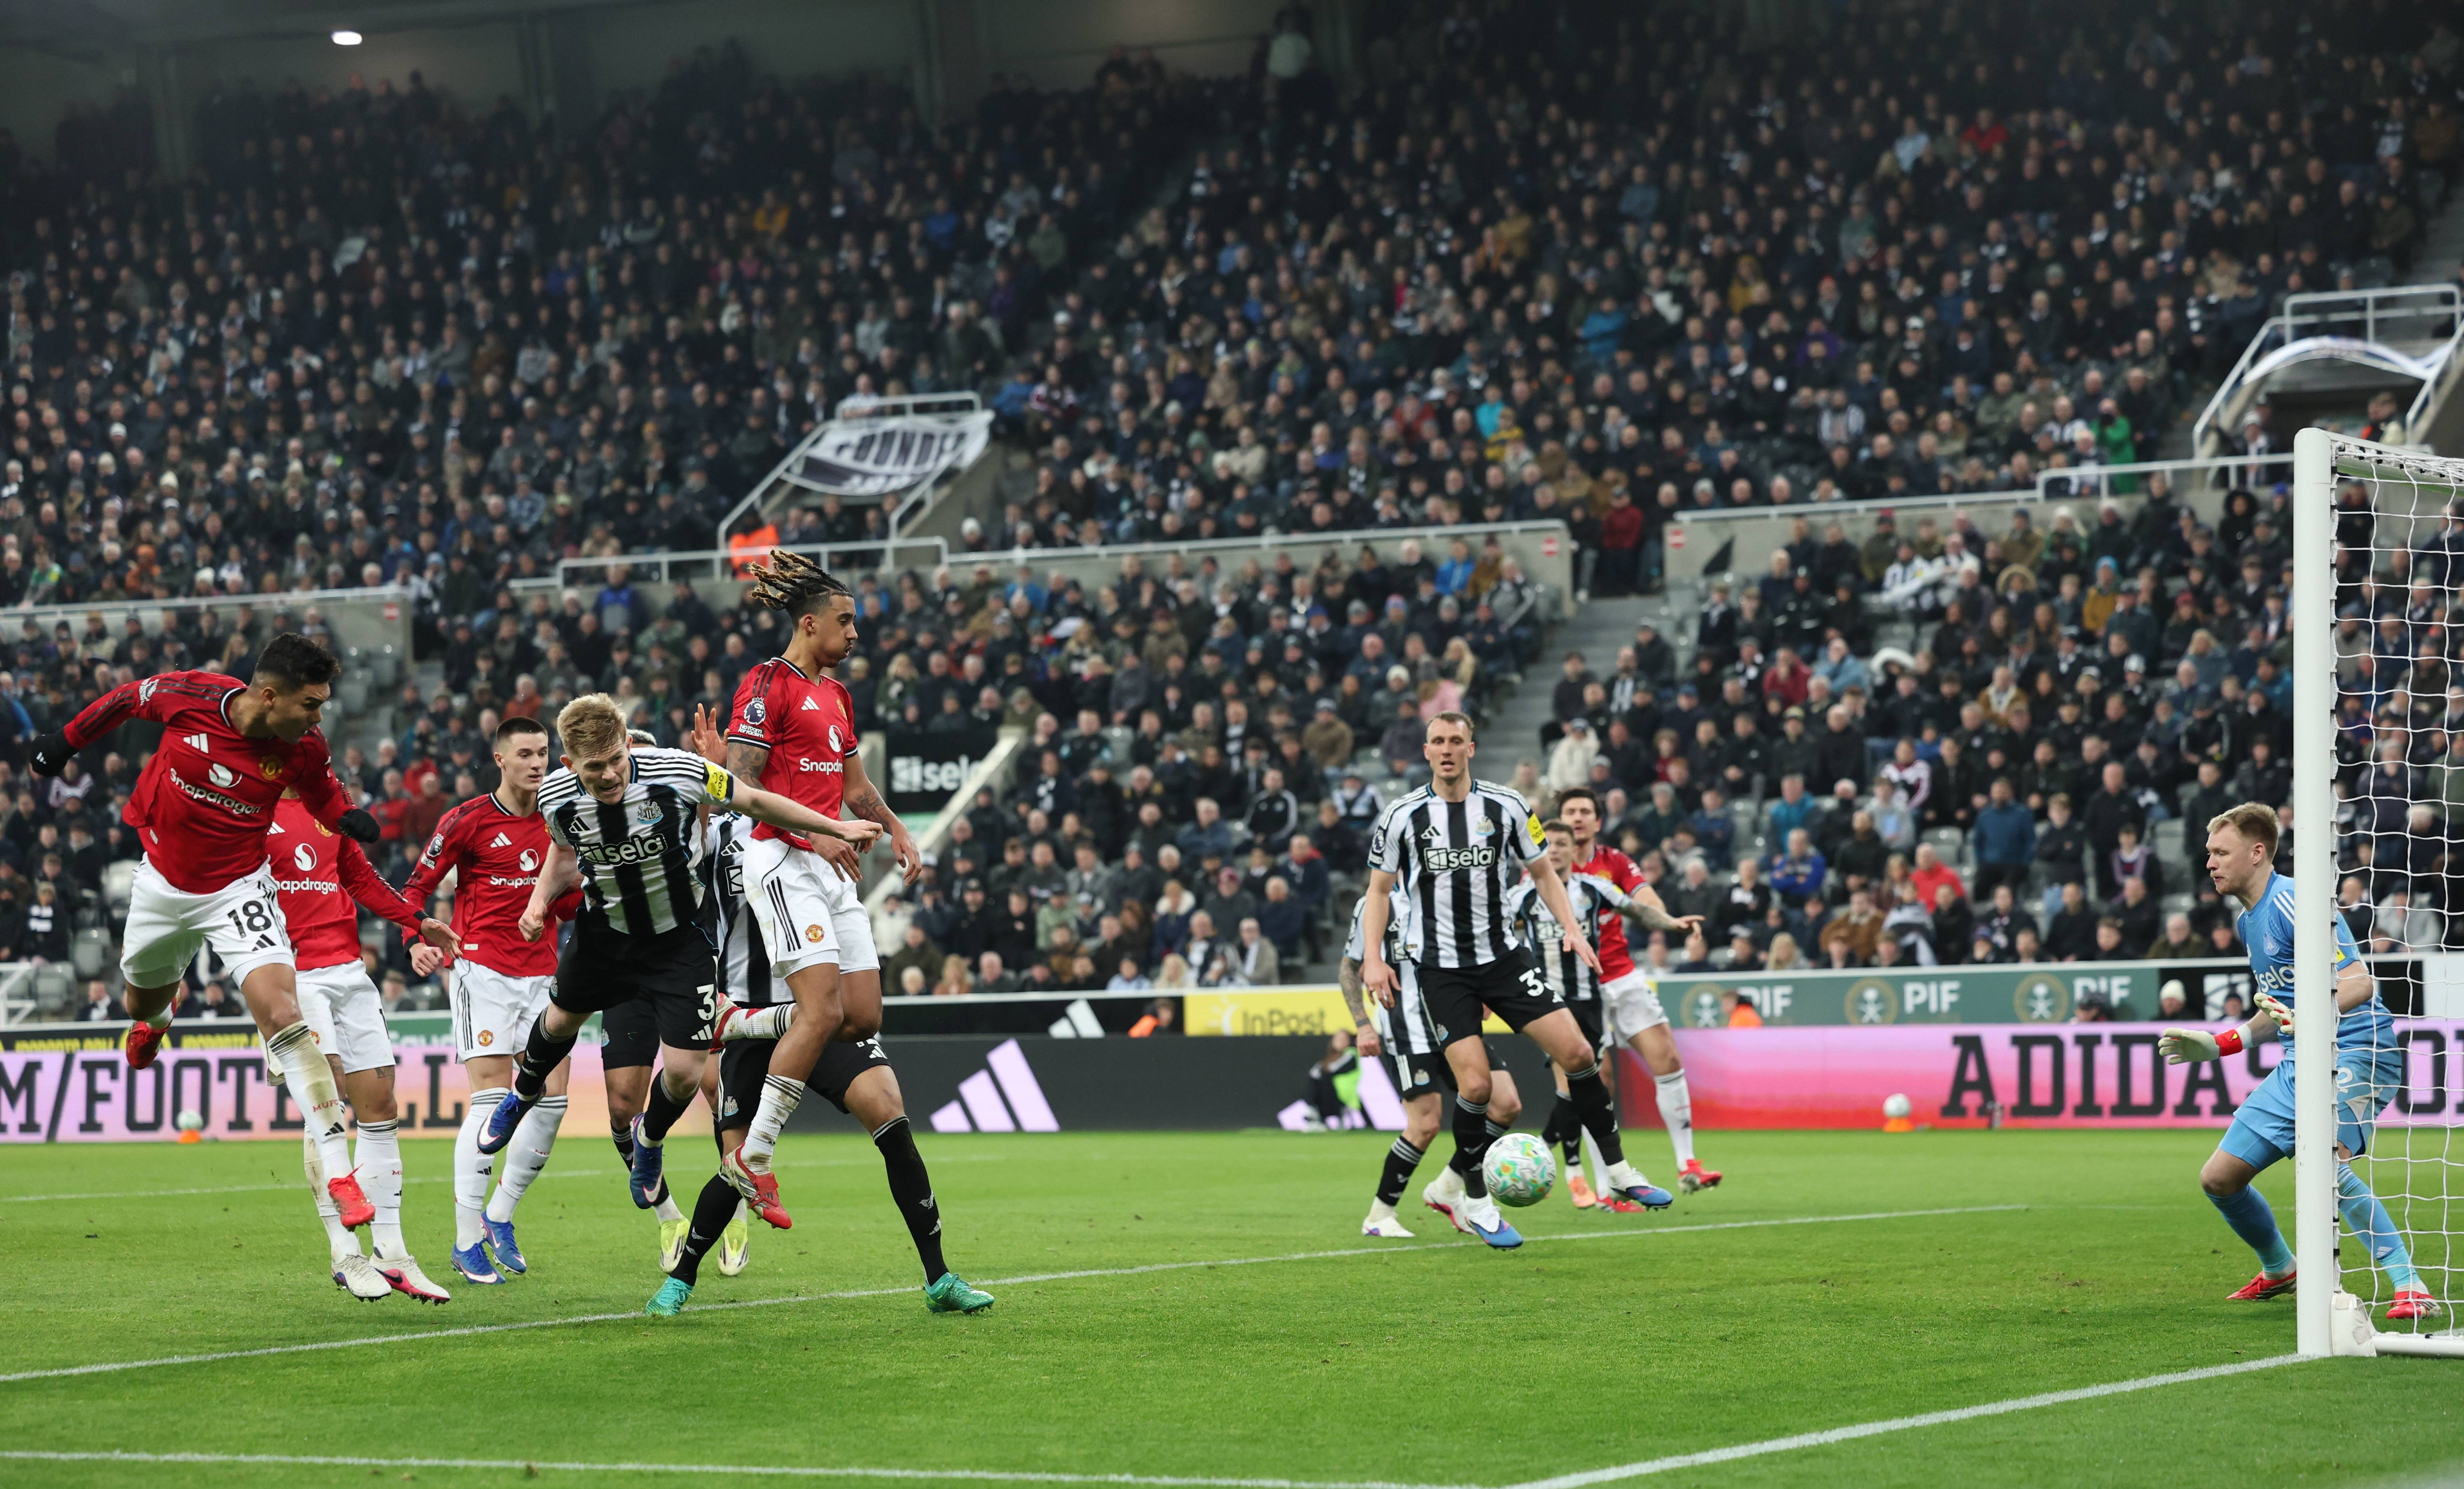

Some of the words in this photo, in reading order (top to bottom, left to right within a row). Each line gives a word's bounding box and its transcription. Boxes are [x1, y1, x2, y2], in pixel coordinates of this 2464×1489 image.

[170, 767, 262, 814] Snapdragon
[605, 836, 664, 863] sela
[1448, 846, 1493, 869] sela
[490, 875, 539, 889] Snapdra
[227, 900, 272, 939] 18
[696, 984, 715, 1020] 3
[1903, 980, 1961, 1014] PIF
[1242, 1008, 1326, 1036] InPost
[313, 1099, 338, 1112] MUFC
